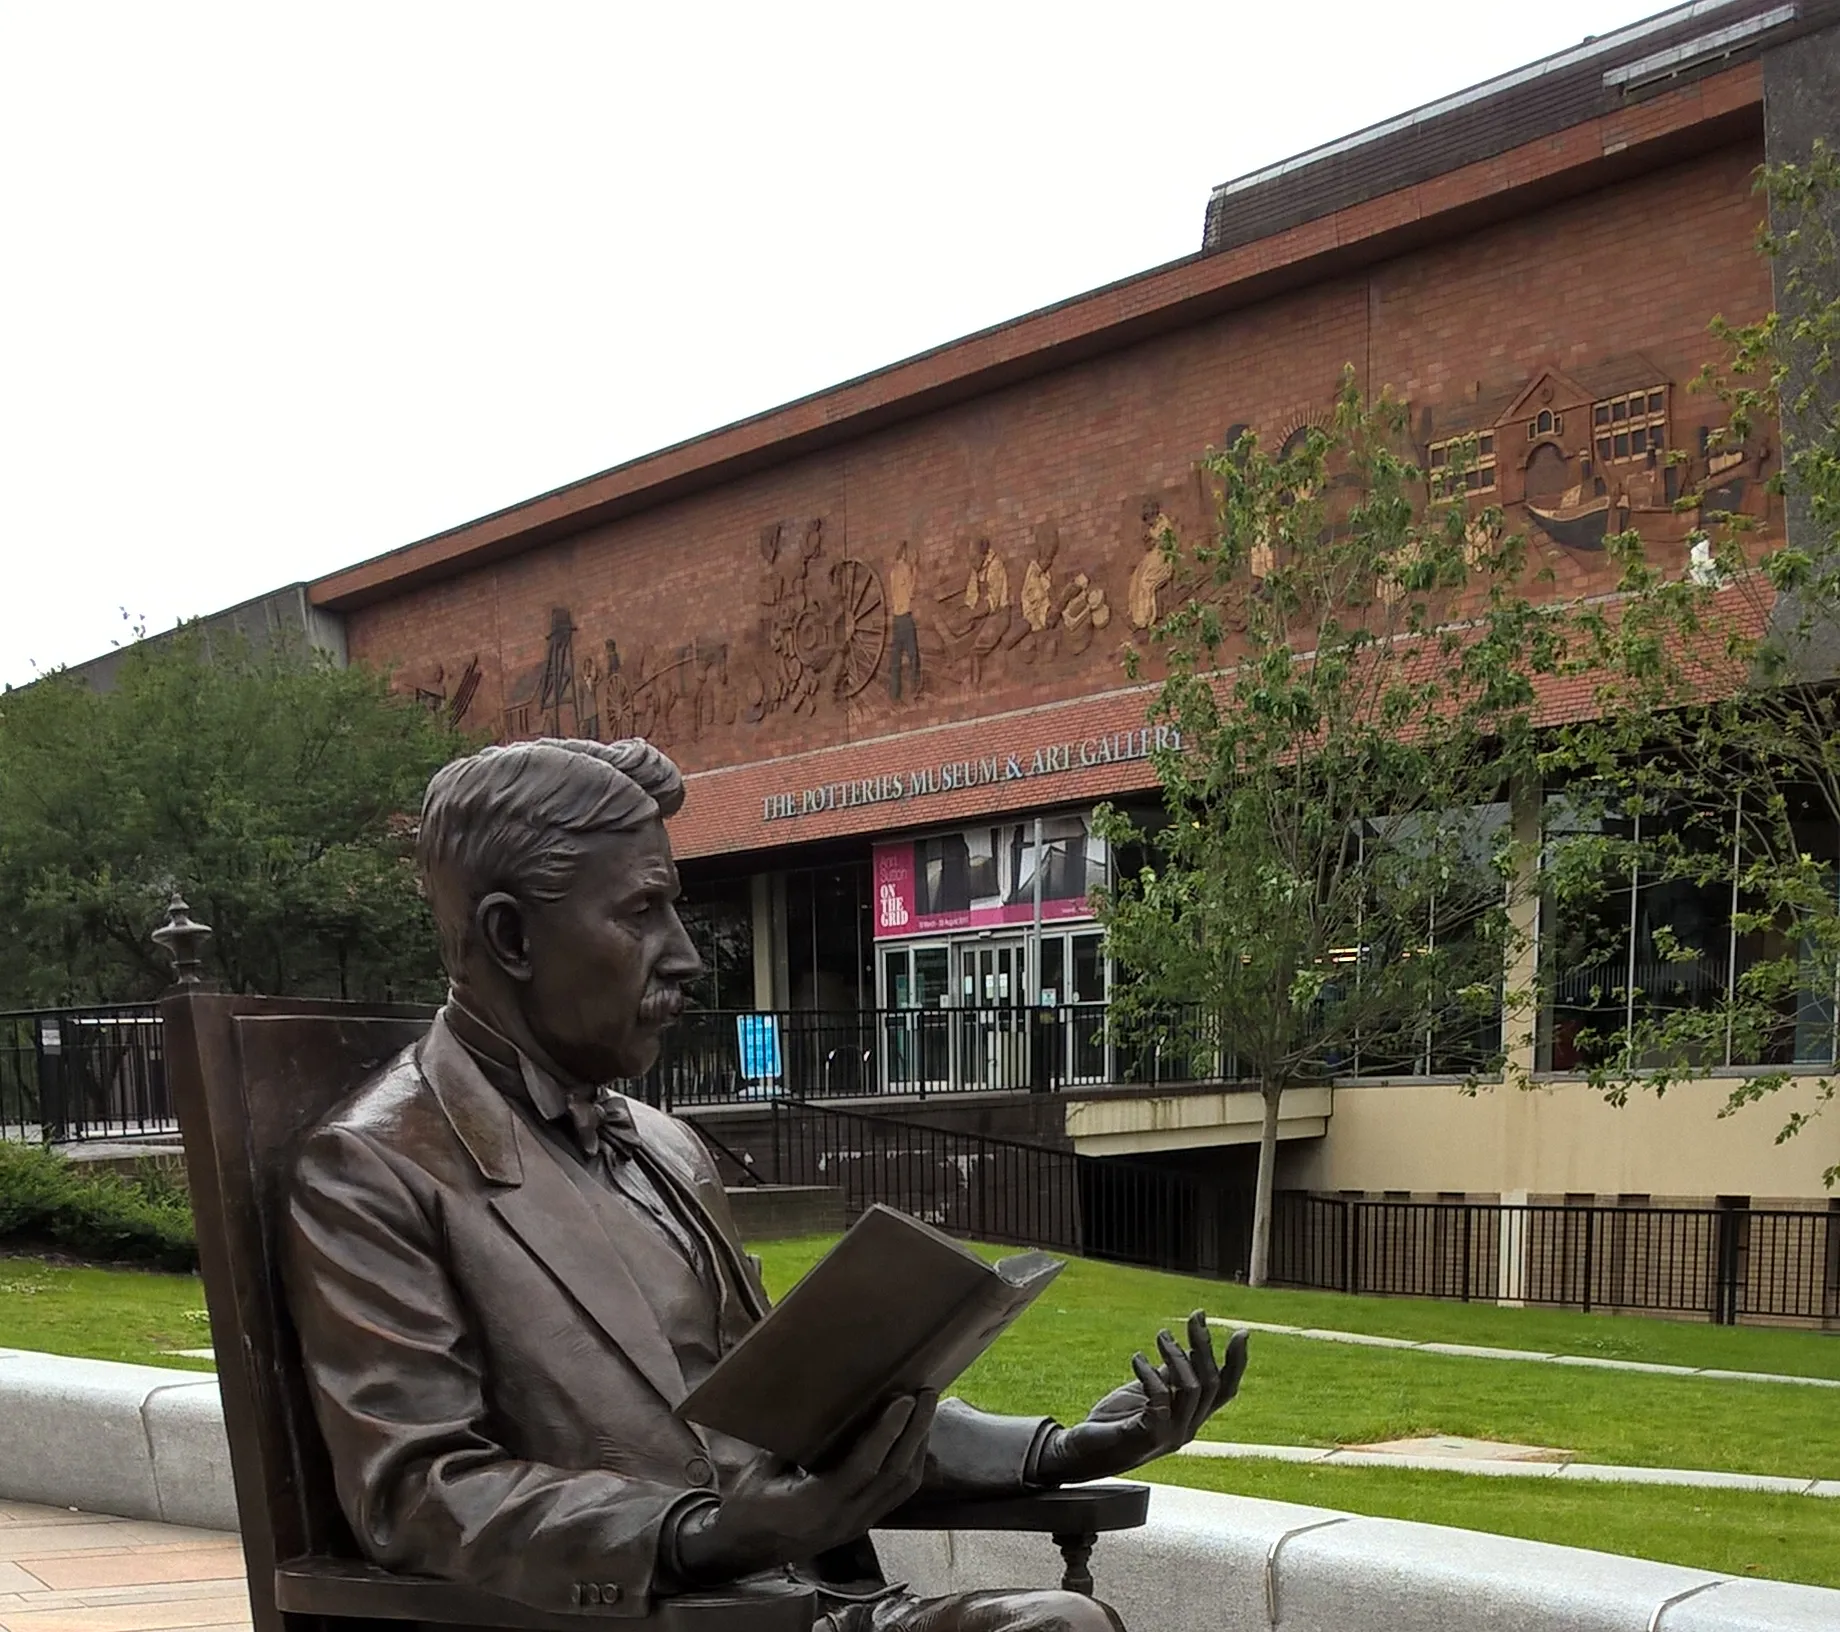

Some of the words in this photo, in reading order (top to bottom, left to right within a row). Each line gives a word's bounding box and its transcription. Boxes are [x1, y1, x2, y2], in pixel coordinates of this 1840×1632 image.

[761, 792, 796, 821] THE
[803, 772, 904, 814] POTTERIES
[910, 755, 999, 796] MUSEUM
[1005, 752, 1024, 780] &
[1030, 743, 1072, 775] ART
[1080, 726, 1182, 766] GALLERY
[880, 883, 896, 899] ON
[880, 896, 904, 913] THE
[880, 910, 909, 928] GRID
